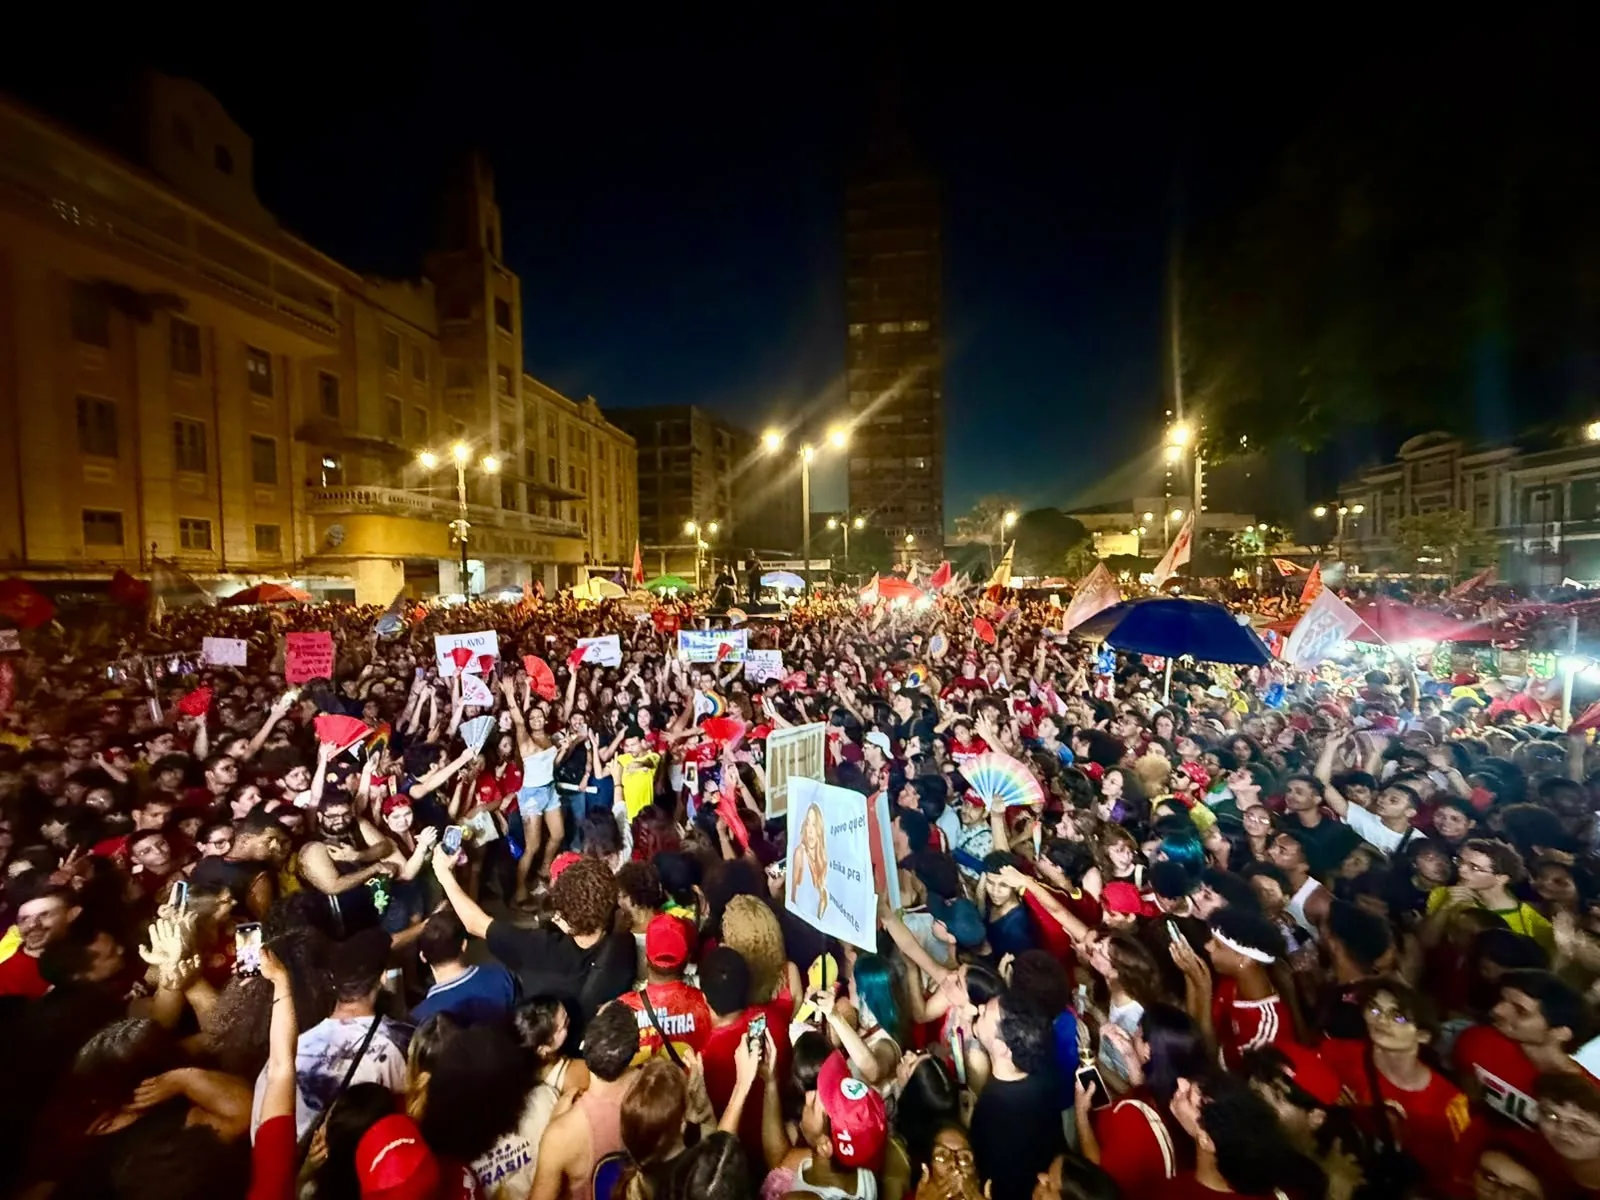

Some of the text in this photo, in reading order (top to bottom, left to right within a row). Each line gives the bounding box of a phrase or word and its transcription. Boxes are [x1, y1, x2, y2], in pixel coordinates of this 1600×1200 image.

[834, 822, 847, 837] povo
[847, 867, 861, 883] pra
[829, 893, 860, 933] presidente
[837, 1129, 855, 1158] 13
[479, 1151, 532, 1186] RASIL
